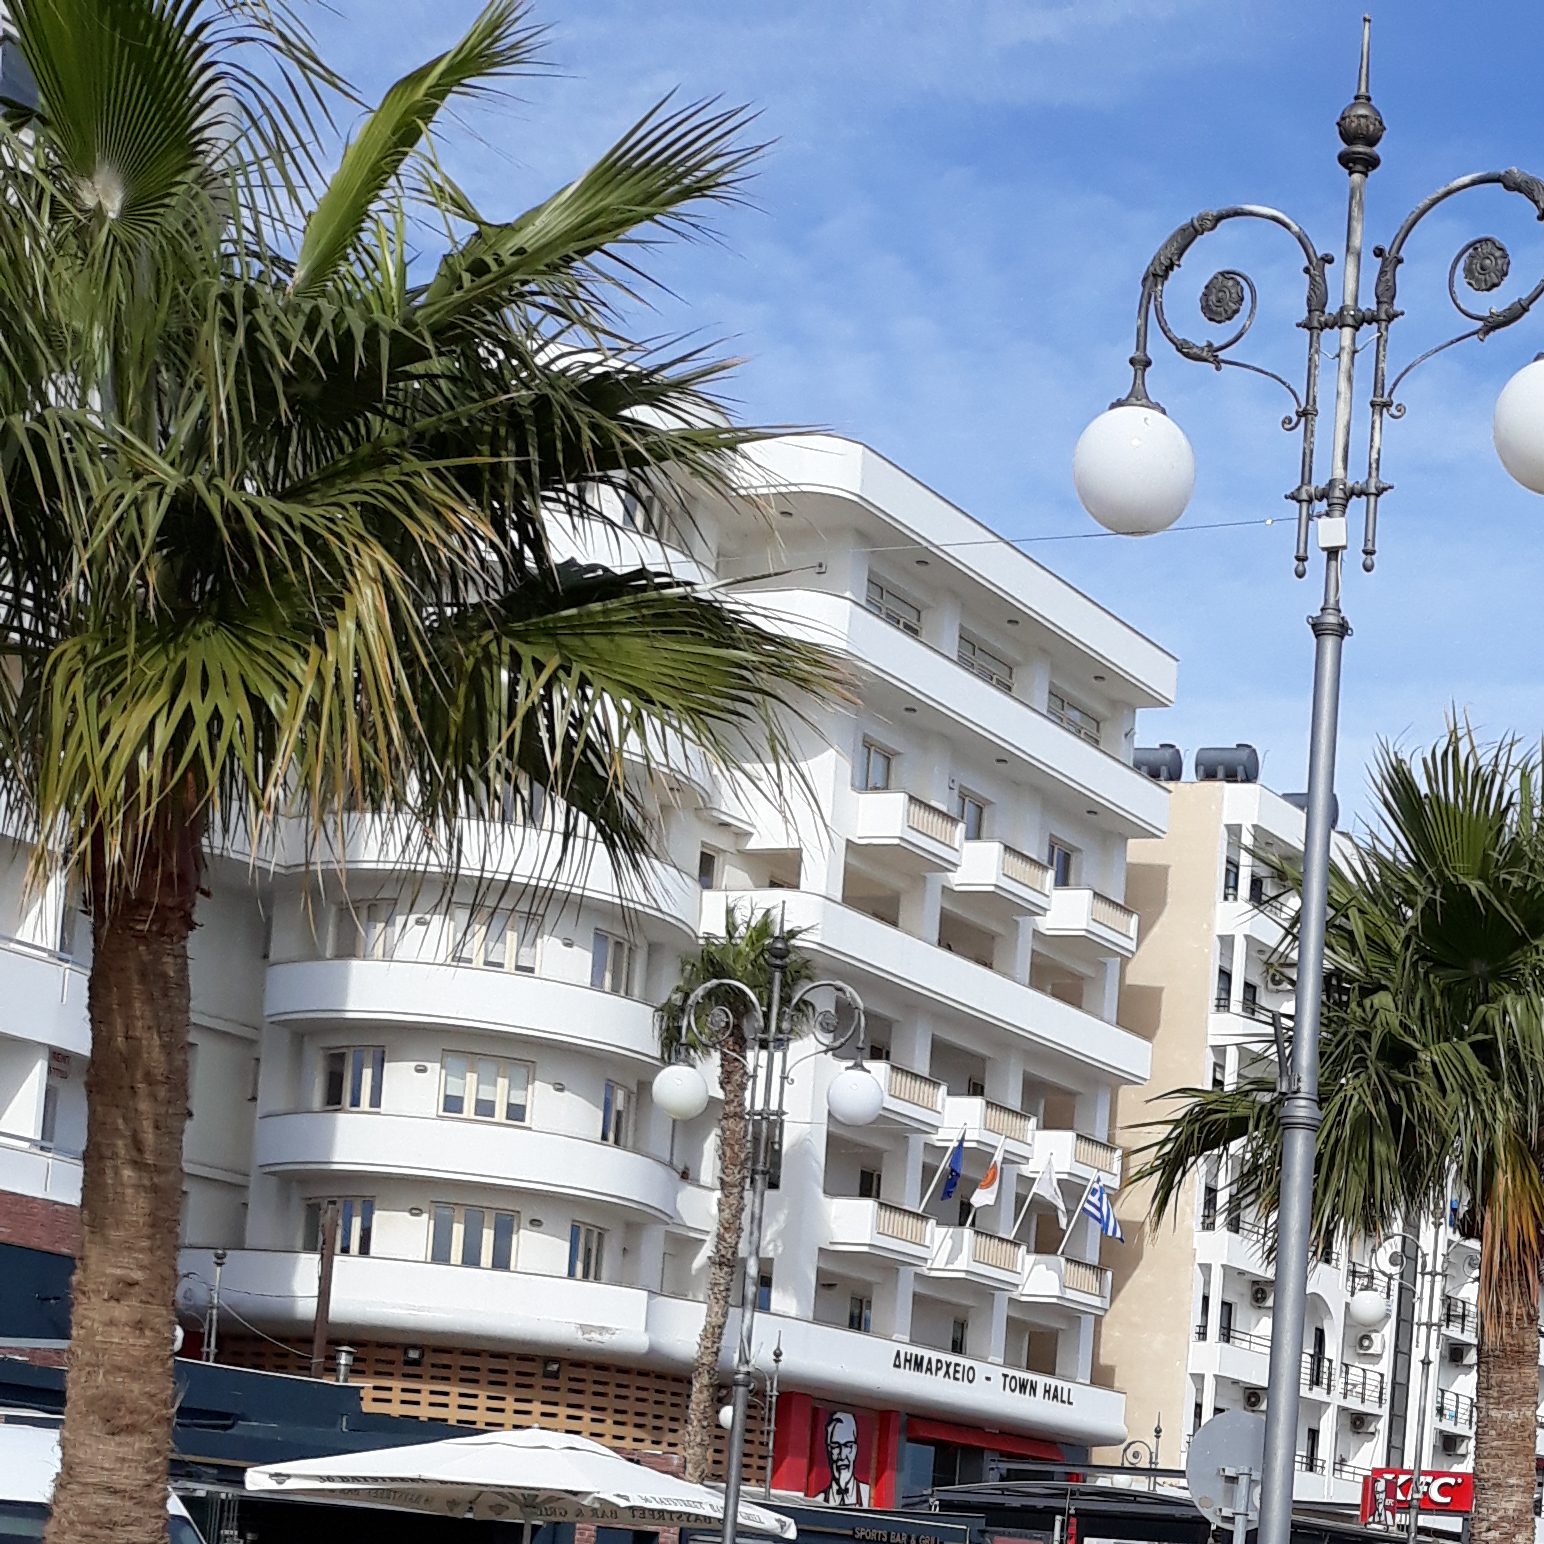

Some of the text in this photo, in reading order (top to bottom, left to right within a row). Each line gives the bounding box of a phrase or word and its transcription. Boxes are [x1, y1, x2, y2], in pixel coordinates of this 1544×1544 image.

[893, 1350, 976, 1384] ΔΗΜΑΡΧΕΙΟ
[1001, 1373, 1038, 1398] TOWN
[1043, 1383, 1074, 1406] HALL
[1382, 1473, 1457, 1503] KFC
[853, 1526, 888, 1542] SPORTS
[889, 1531, 907, 1544] BAR
[910, 1534, 917, 1544] &
